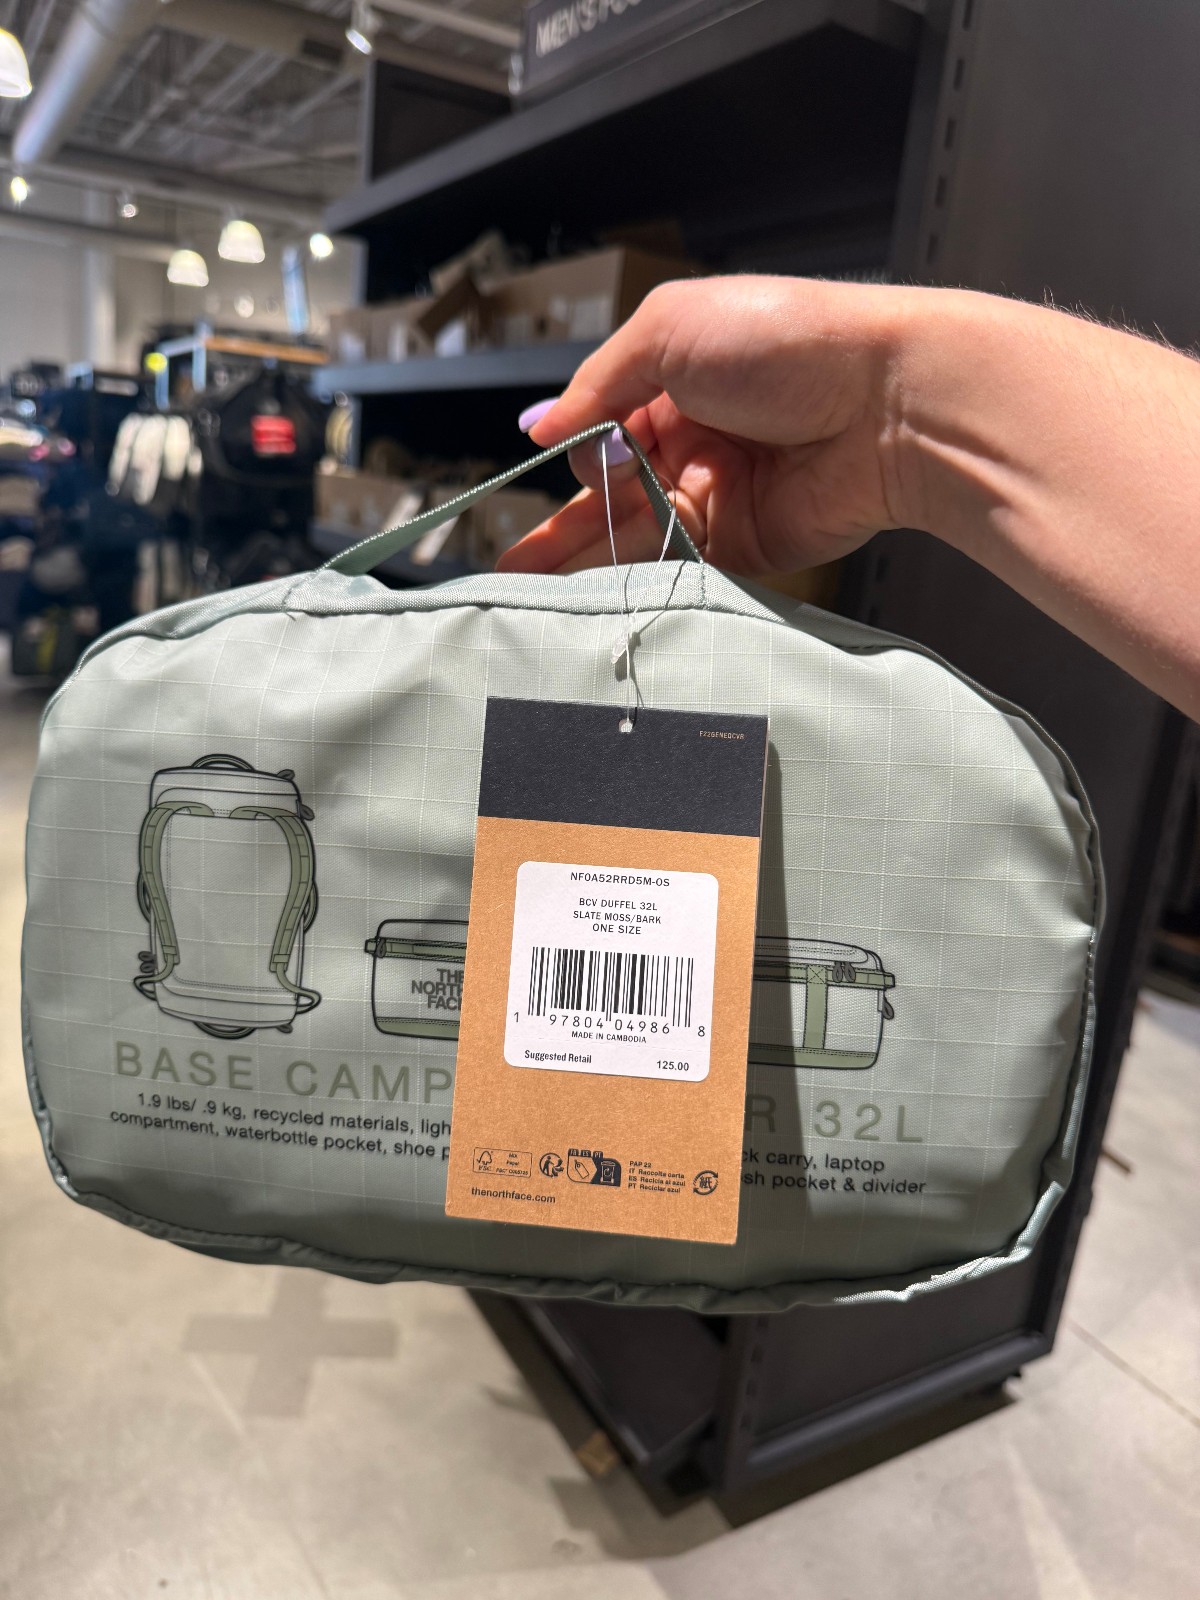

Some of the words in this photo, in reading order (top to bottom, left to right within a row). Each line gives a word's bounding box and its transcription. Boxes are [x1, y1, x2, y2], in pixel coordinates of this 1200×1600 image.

[579, 897, 598, 907] BCV
[600, 899, 637, 910] DUFFEL
[639, 902, 658, 911] 32L
[573, 910, 601, 920] SLATE
[604, 912, 662, 924] MOSS/BARK
[592, 923, 614, 933] ONE
[618, 925, 642, 935] SIZE
[513, 1012, 520, 1023] 1
[549, 1014, 604, 1029] 97804
[614, 1019, 670, 1034] 04986
[697, 1026, 706, 1037] 8
[571, 1030, 593, 1039] MADE
[596, 1032, 604, 1040] IN
[606, 1033, 647, 1043] CAMBODIA
[524, 1050, 567, 1062] Suggested
[568, 1053, 592, 1064] Retail
[115, 1040, 254, 1091] BASE
[286, 1060, 454, 1104] CAMP
[656, 1060, 690, 1071] 125.00
[138, 1092, 162, 1108] 1.9
[167, 1095, 198, 1112] lbs/
[202, 1100, 217, 1114] .9
[223, 1102, 247, 1120] kg,
[253, 1107, 324, 1127] recycled
[330, 1112, 415, 1134] materials,
[813, 1099, 924, 1143] 32L
[110, 1109, 220, 1137] compartment,
[225, 1124, 319, 1147] waterbottle
[323, 1133, 388, 1155] pocket,
[393, 1139, 436, 1158] shoe
[629, 1160, 643, 1168] PAP
[766, 1151, 817, 1170] carry,
[824, 1153, 885, 1174] laptop
[638, 1168, 667, 1177] Raccolta
[628, 1182, 636, 1190] PT
[667, 1186, 681, 1194] azul
[672, 1179, 686, 1187] azul
[742, 1170, 765, 1186] sh
[772, 1174, 836, 1191] pocket
[843, 1179, 856, 1192] &
[862, 1178, 927, 1194] divider
[471, 1186, 556, 1204] thenorthface.com
